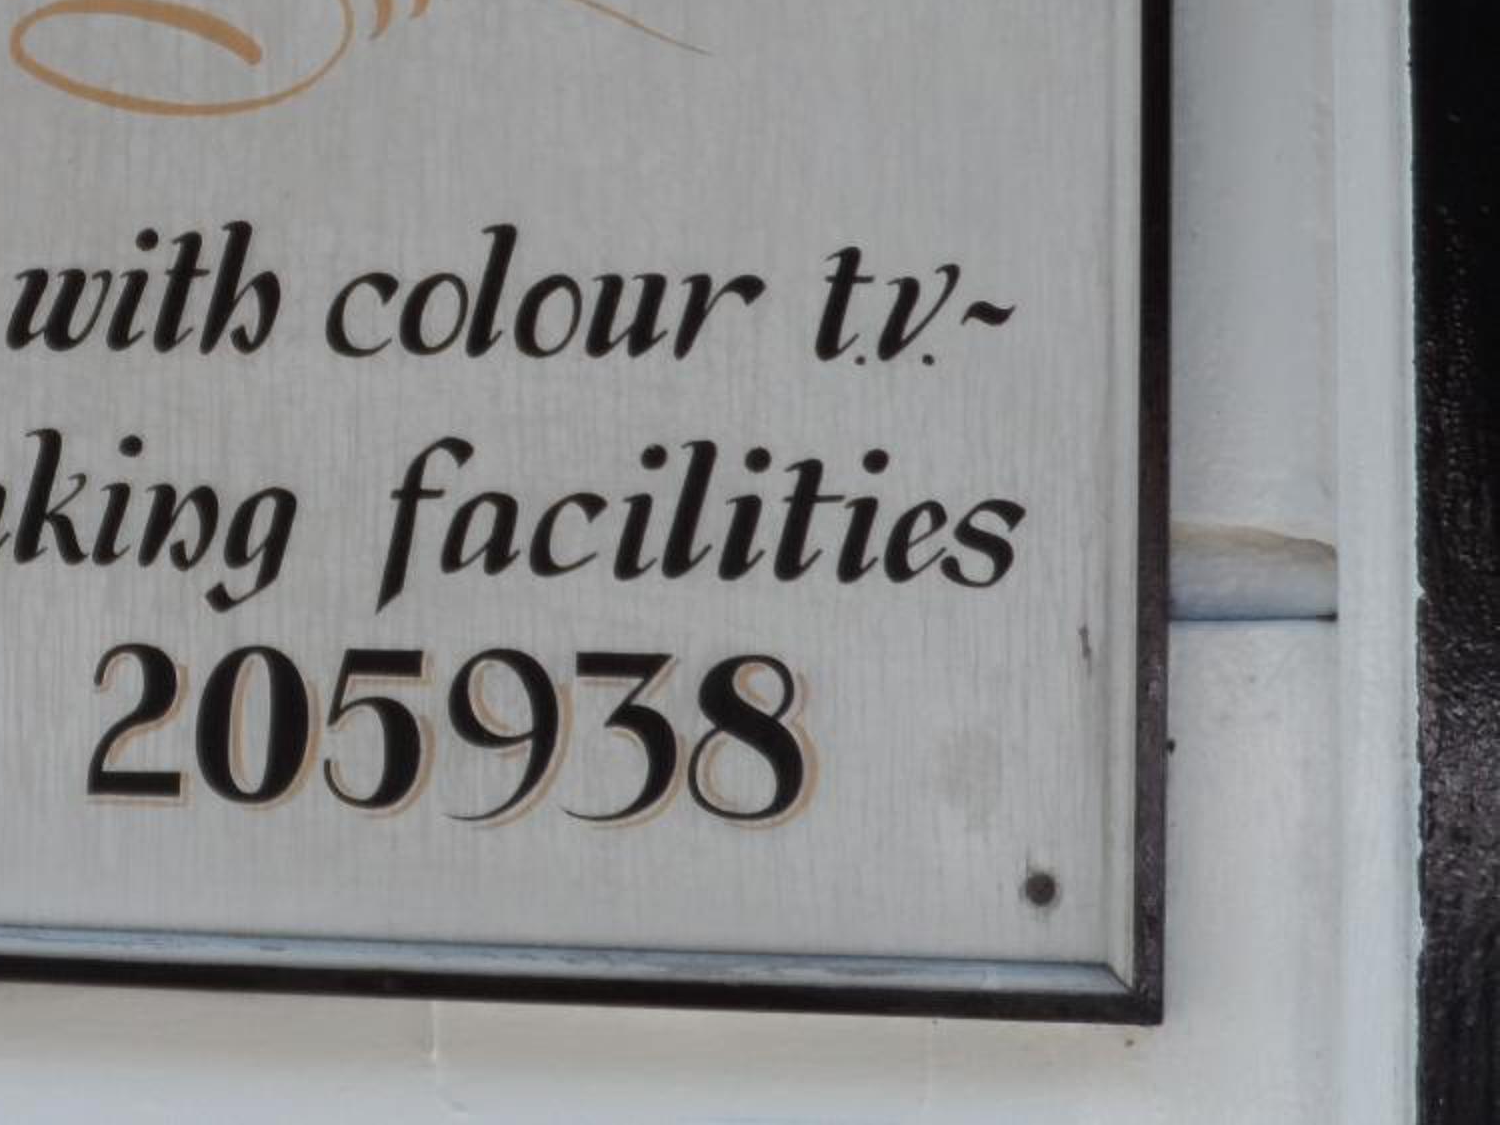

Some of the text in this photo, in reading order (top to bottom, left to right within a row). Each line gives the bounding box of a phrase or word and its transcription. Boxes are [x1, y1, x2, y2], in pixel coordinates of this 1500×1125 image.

[4, 220, 281, 355] with
[325, 224, 767, 359] colour
[376, 436, 1027, 614] facilities
[86, 642, 806, 823] 205938
